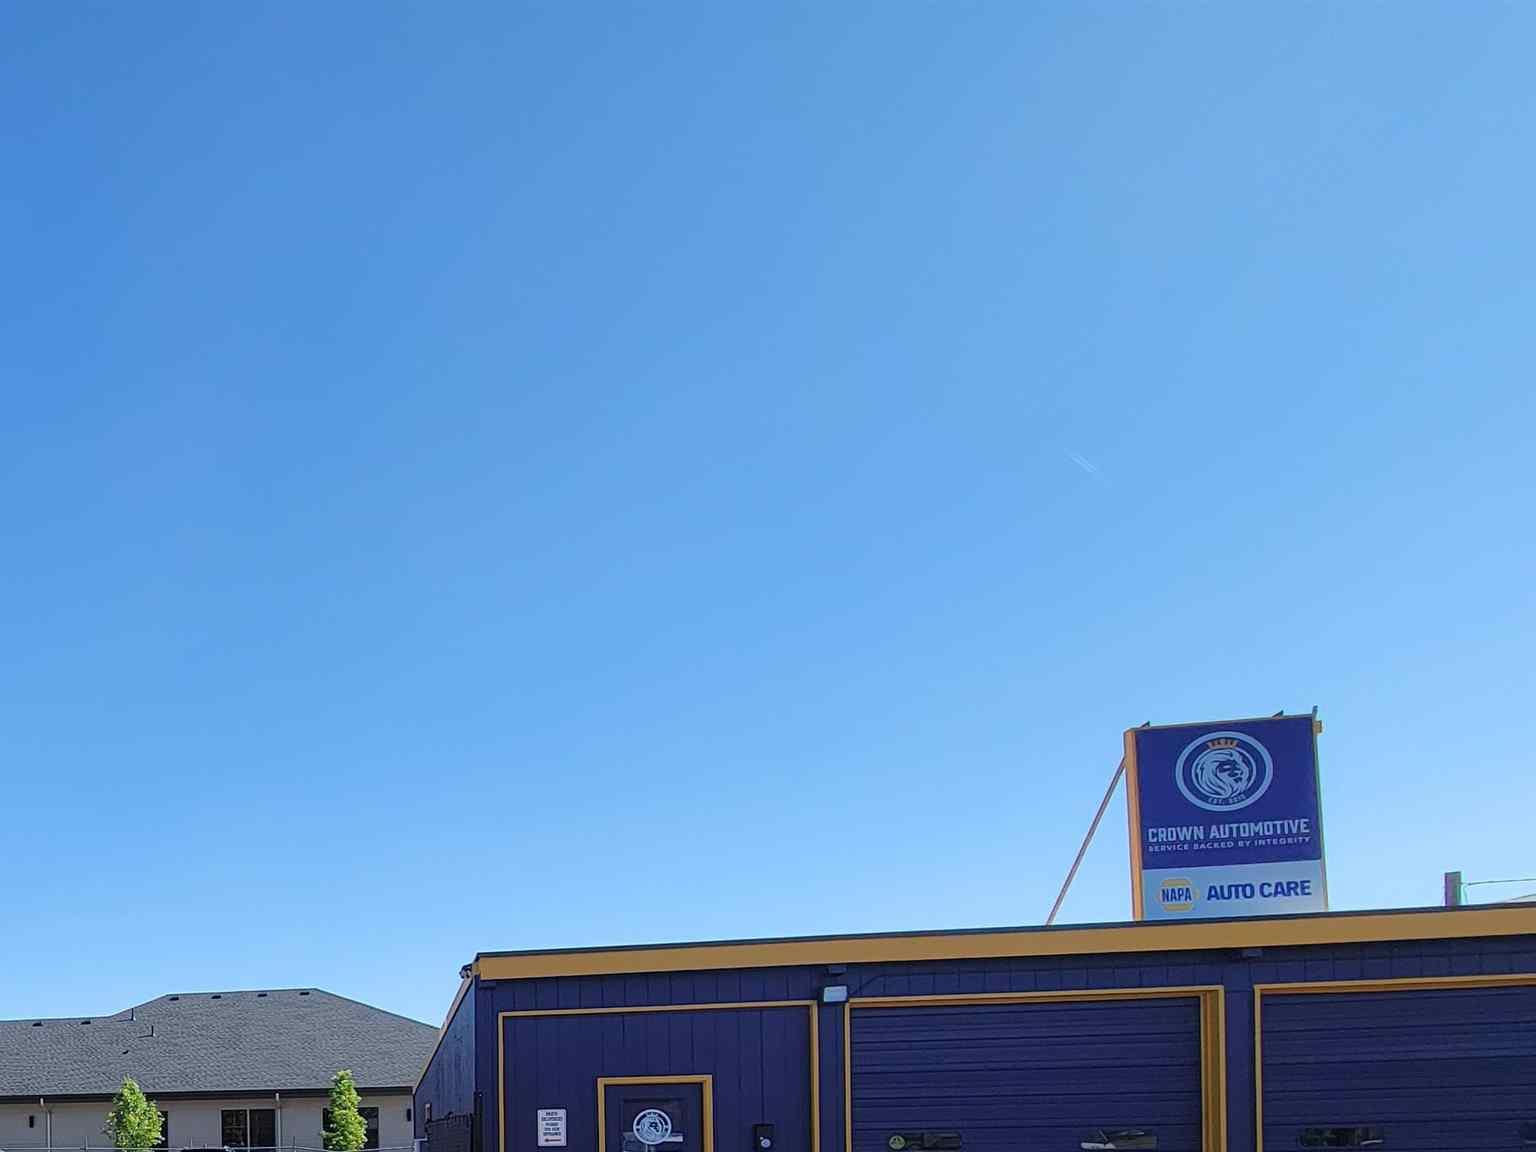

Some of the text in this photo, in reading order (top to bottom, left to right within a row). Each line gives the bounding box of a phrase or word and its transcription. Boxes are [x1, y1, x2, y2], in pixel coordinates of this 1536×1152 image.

[1148, 819, 1310, 842] CROWN AUTOMOTIVE
[1148, 836, 1312, 852] SERVICE BACKED BY INTEGRITY
[1161, 879, 1312, 903] NAPA AUTO CARE
